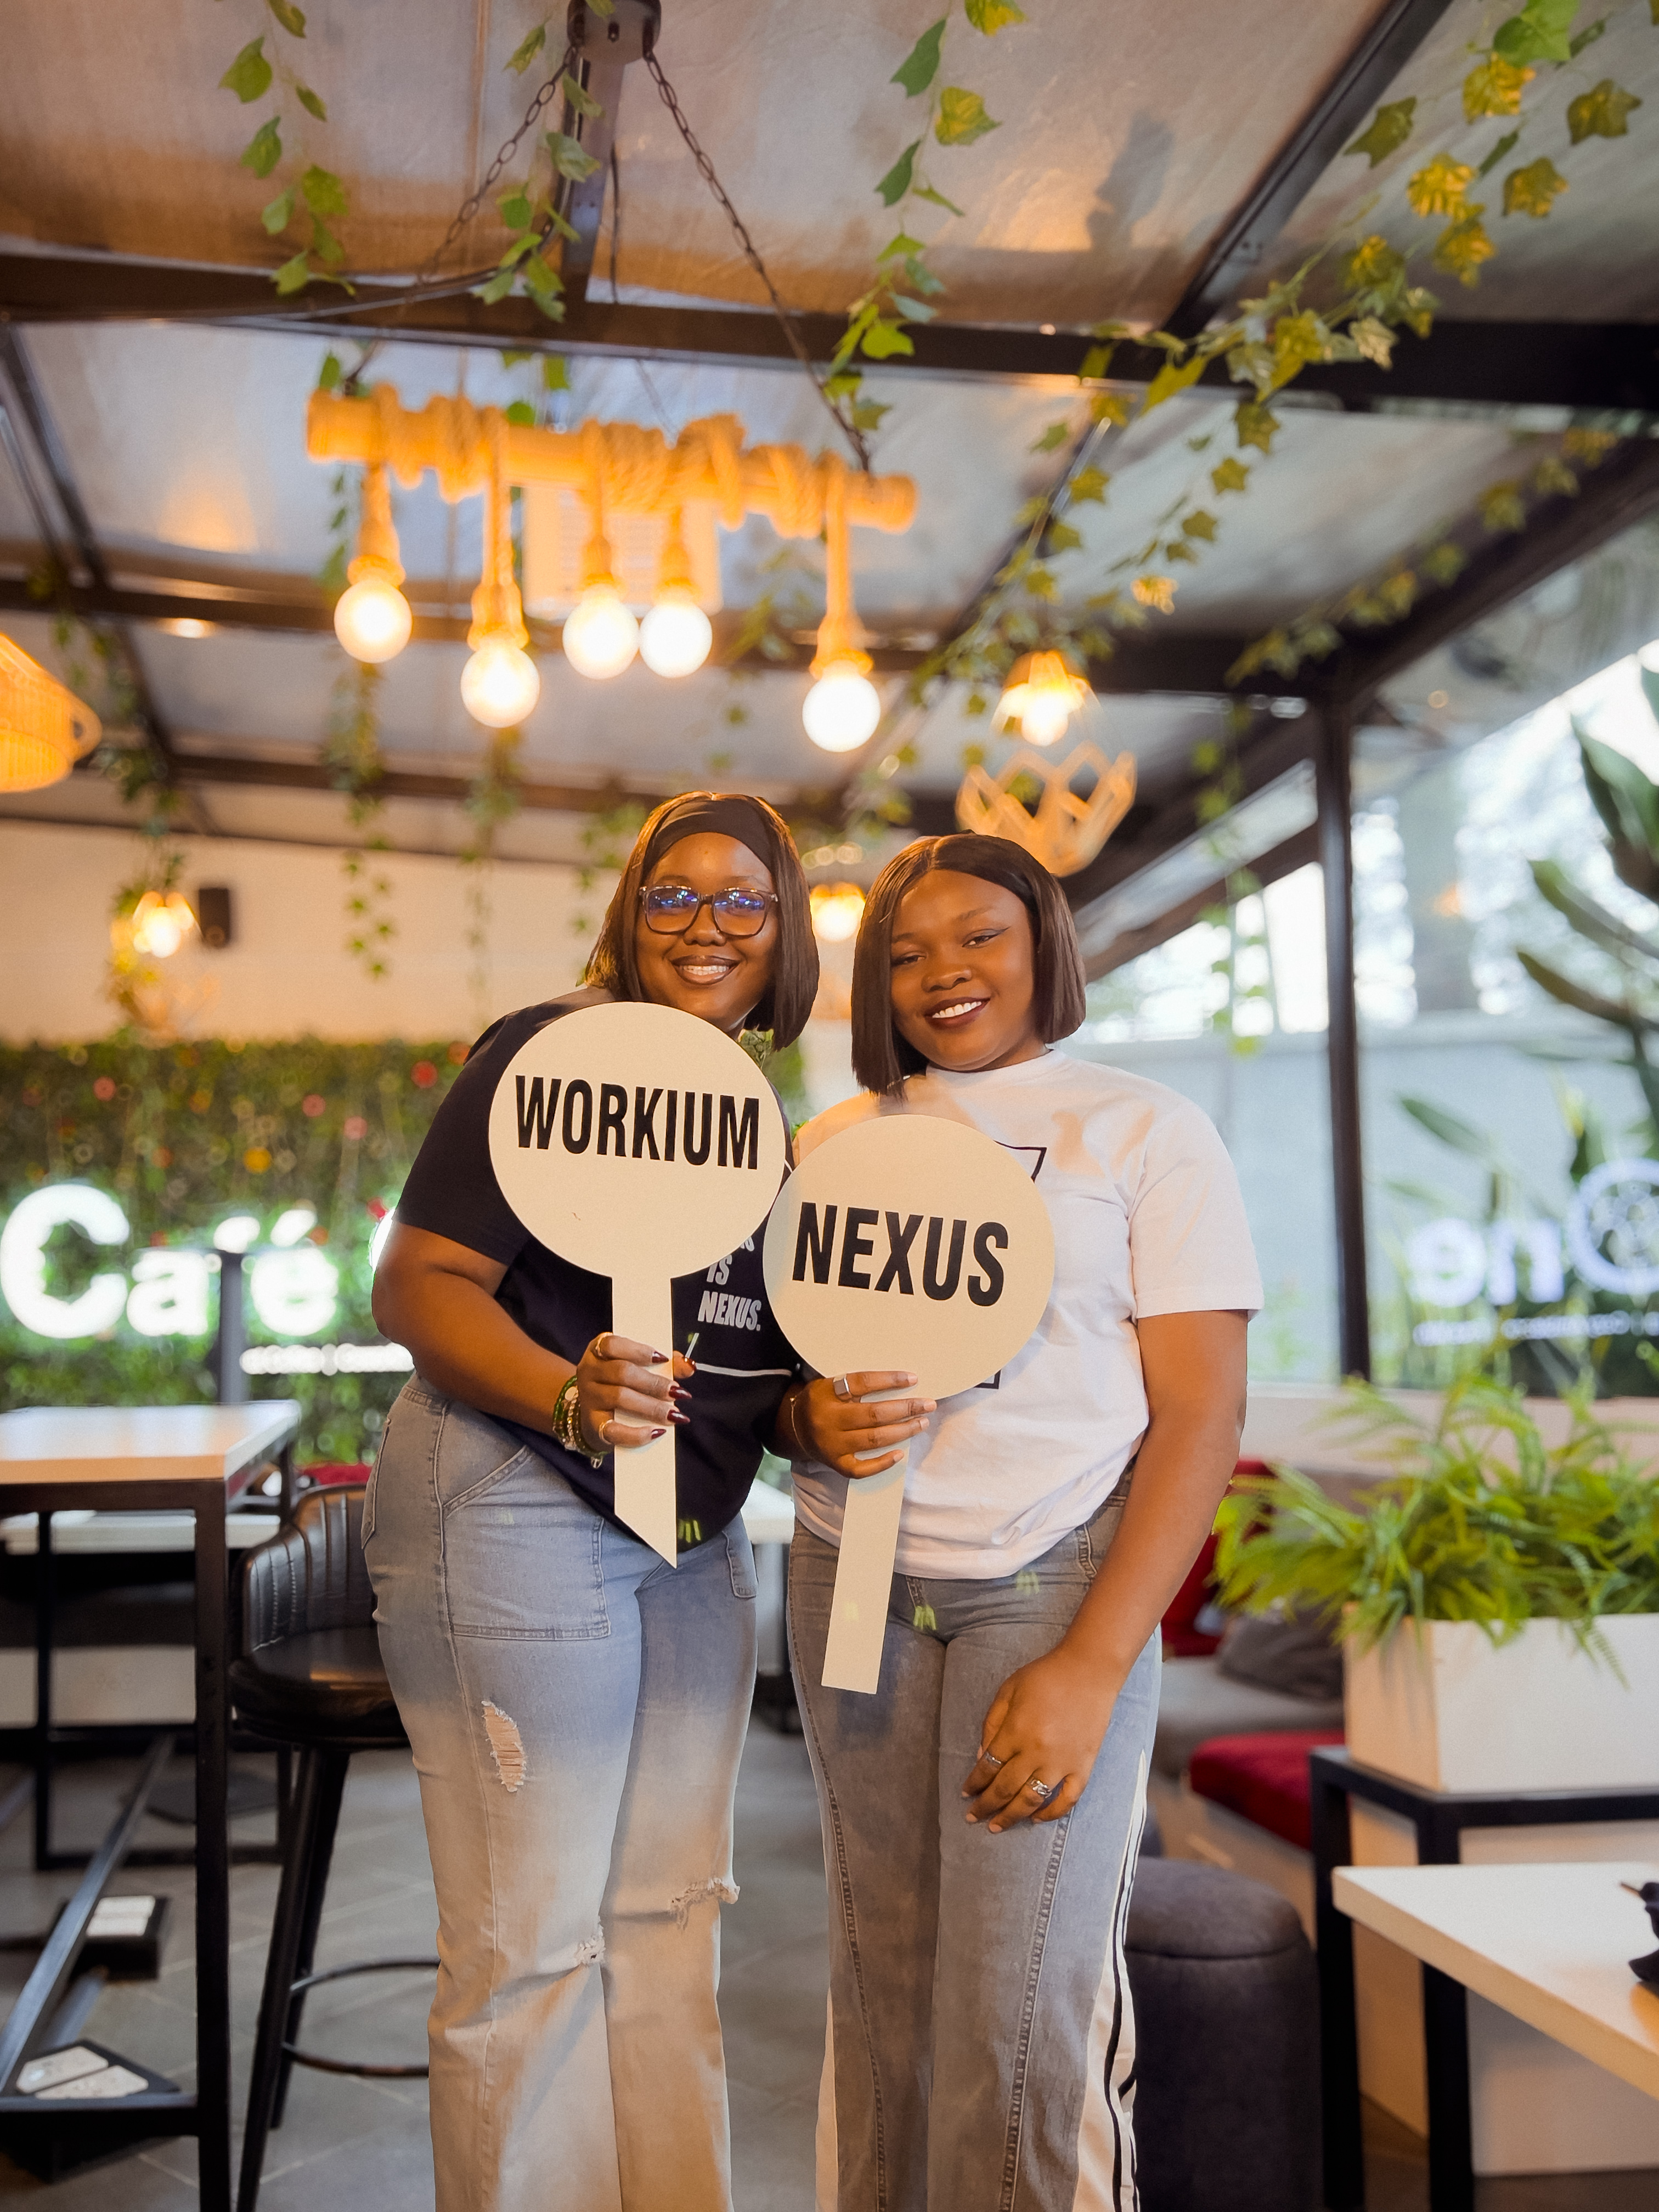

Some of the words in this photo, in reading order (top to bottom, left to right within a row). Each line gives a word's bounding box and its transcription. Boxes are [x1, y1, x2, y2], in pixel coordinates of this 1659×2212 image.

[515, 1075, 760, 1170] WORKIUM
[706, 1254, 732, 1285] IS
[792, 1201, 1009, 1307] NEXUS
[697, 1290, 762, 1331] NEXUS.
